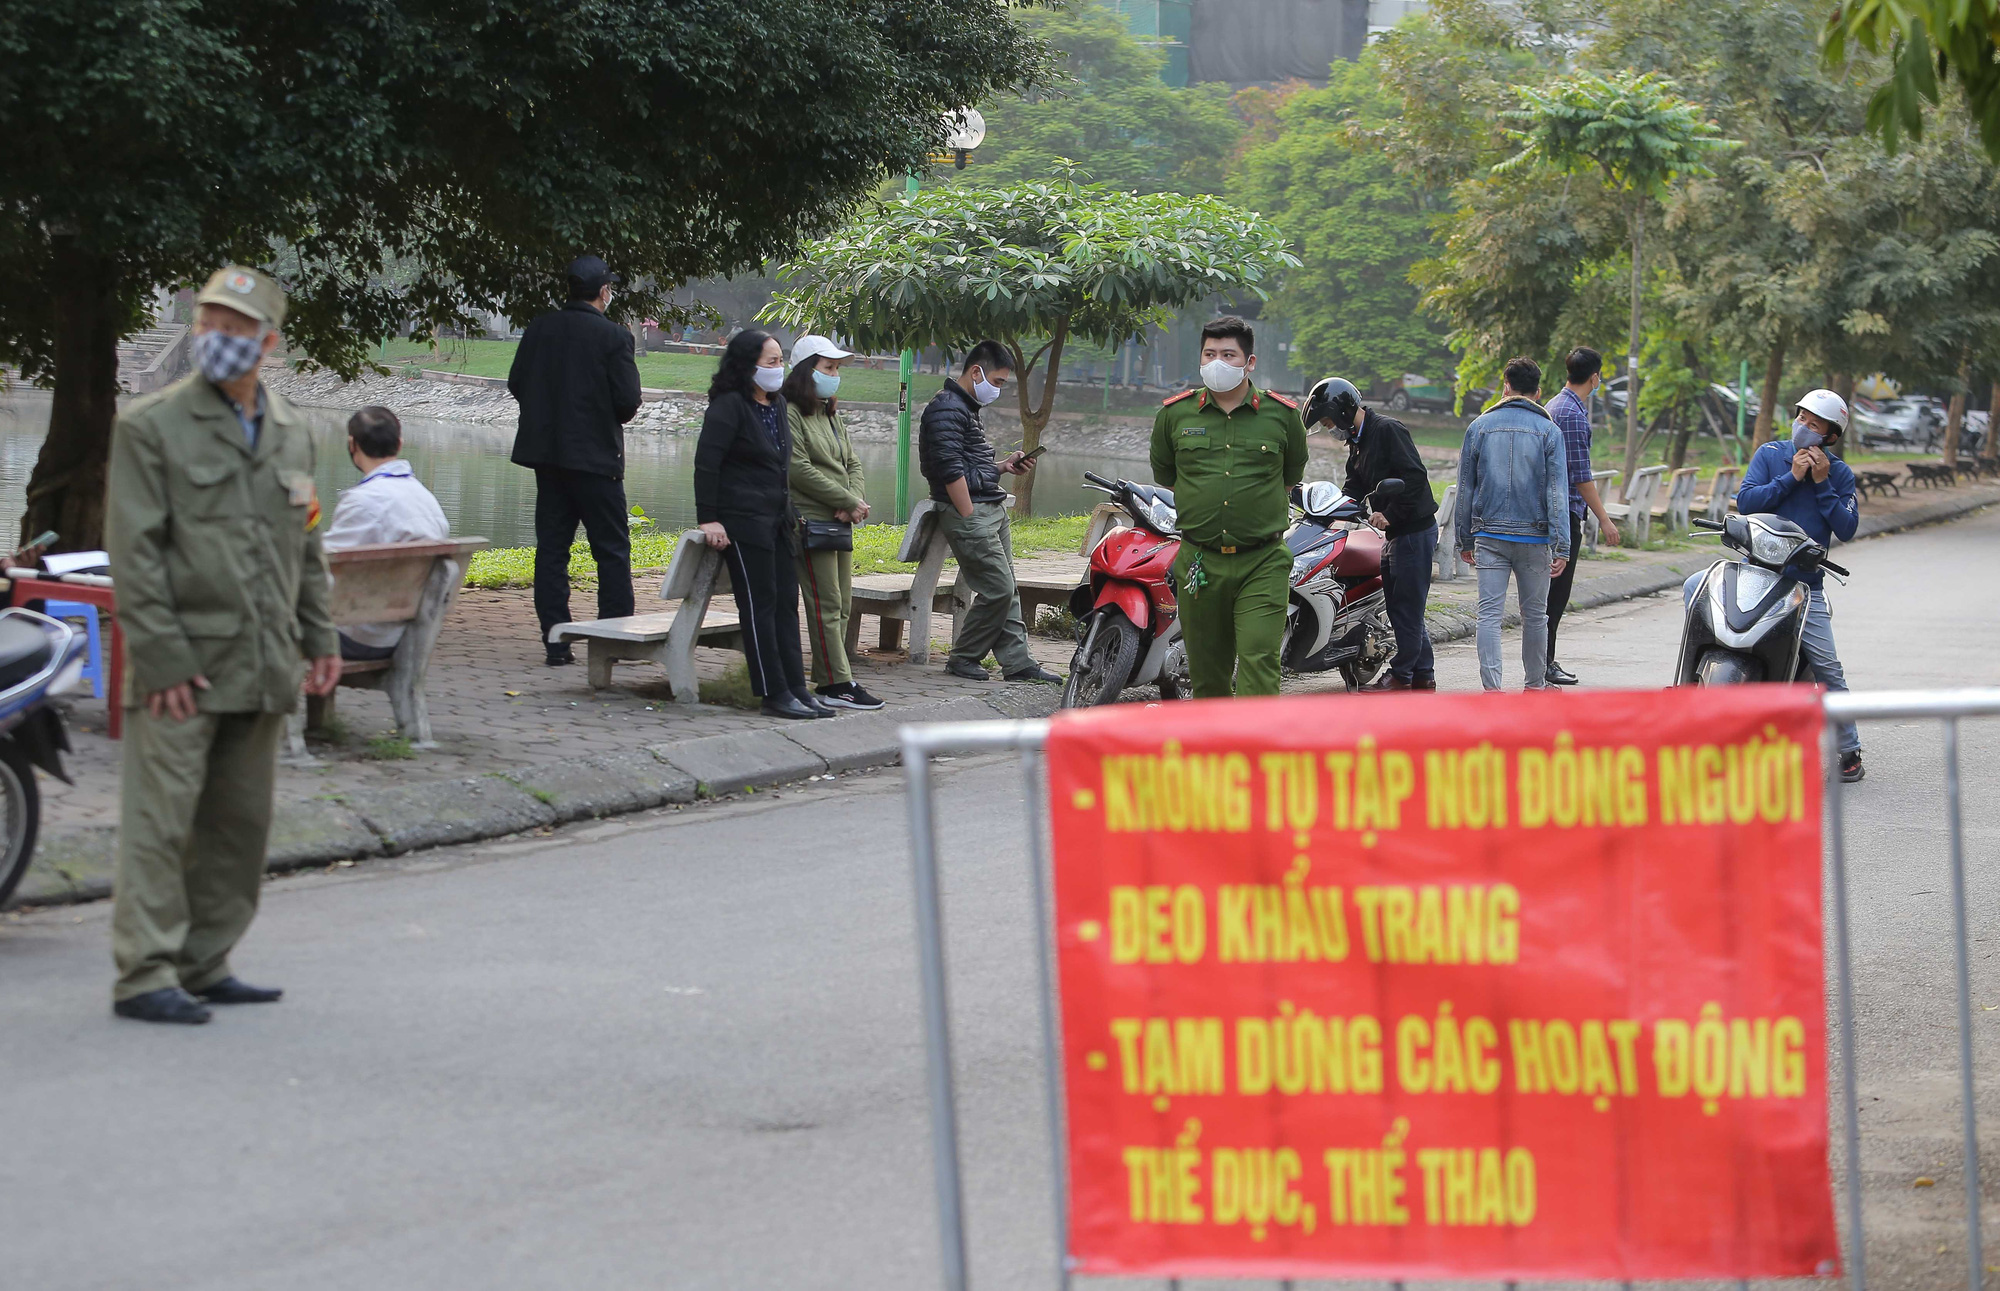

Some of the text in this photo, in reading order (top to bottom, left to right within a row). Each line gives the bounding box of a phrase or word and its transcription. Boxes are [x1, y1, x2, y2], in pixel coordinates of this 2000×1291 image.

[1101, 739, 1252, 833] KHÔNG
[1259, 751, 1319, 849] TỤ
[1324, 735, 1415, 848] TẬP
[1424, 741, 1508, 830] NƠI
[1516, 731, 1649, 829] ĐÔNG
[1657, 724, 1805, 825] NGƯỜI
[1108, 884, 1207, 964] ĐEO
[1217, 853, 1350, 963] KHẨU
[1353, 883, 1521, 966] TRANG
[1109, 1016, 1225, 1112] TẠM
[1235, 999, 1385, 1096] DỪNG
[1396, 999, 1502, 1095] CÁC
[1508, 1019, 1642, 1113] HOẠT
[1652, 1001, 1807, 1116] ĐỘNG
[1122, 1116, 1538, 1242] THỂ DỤC, THỂ THAO
